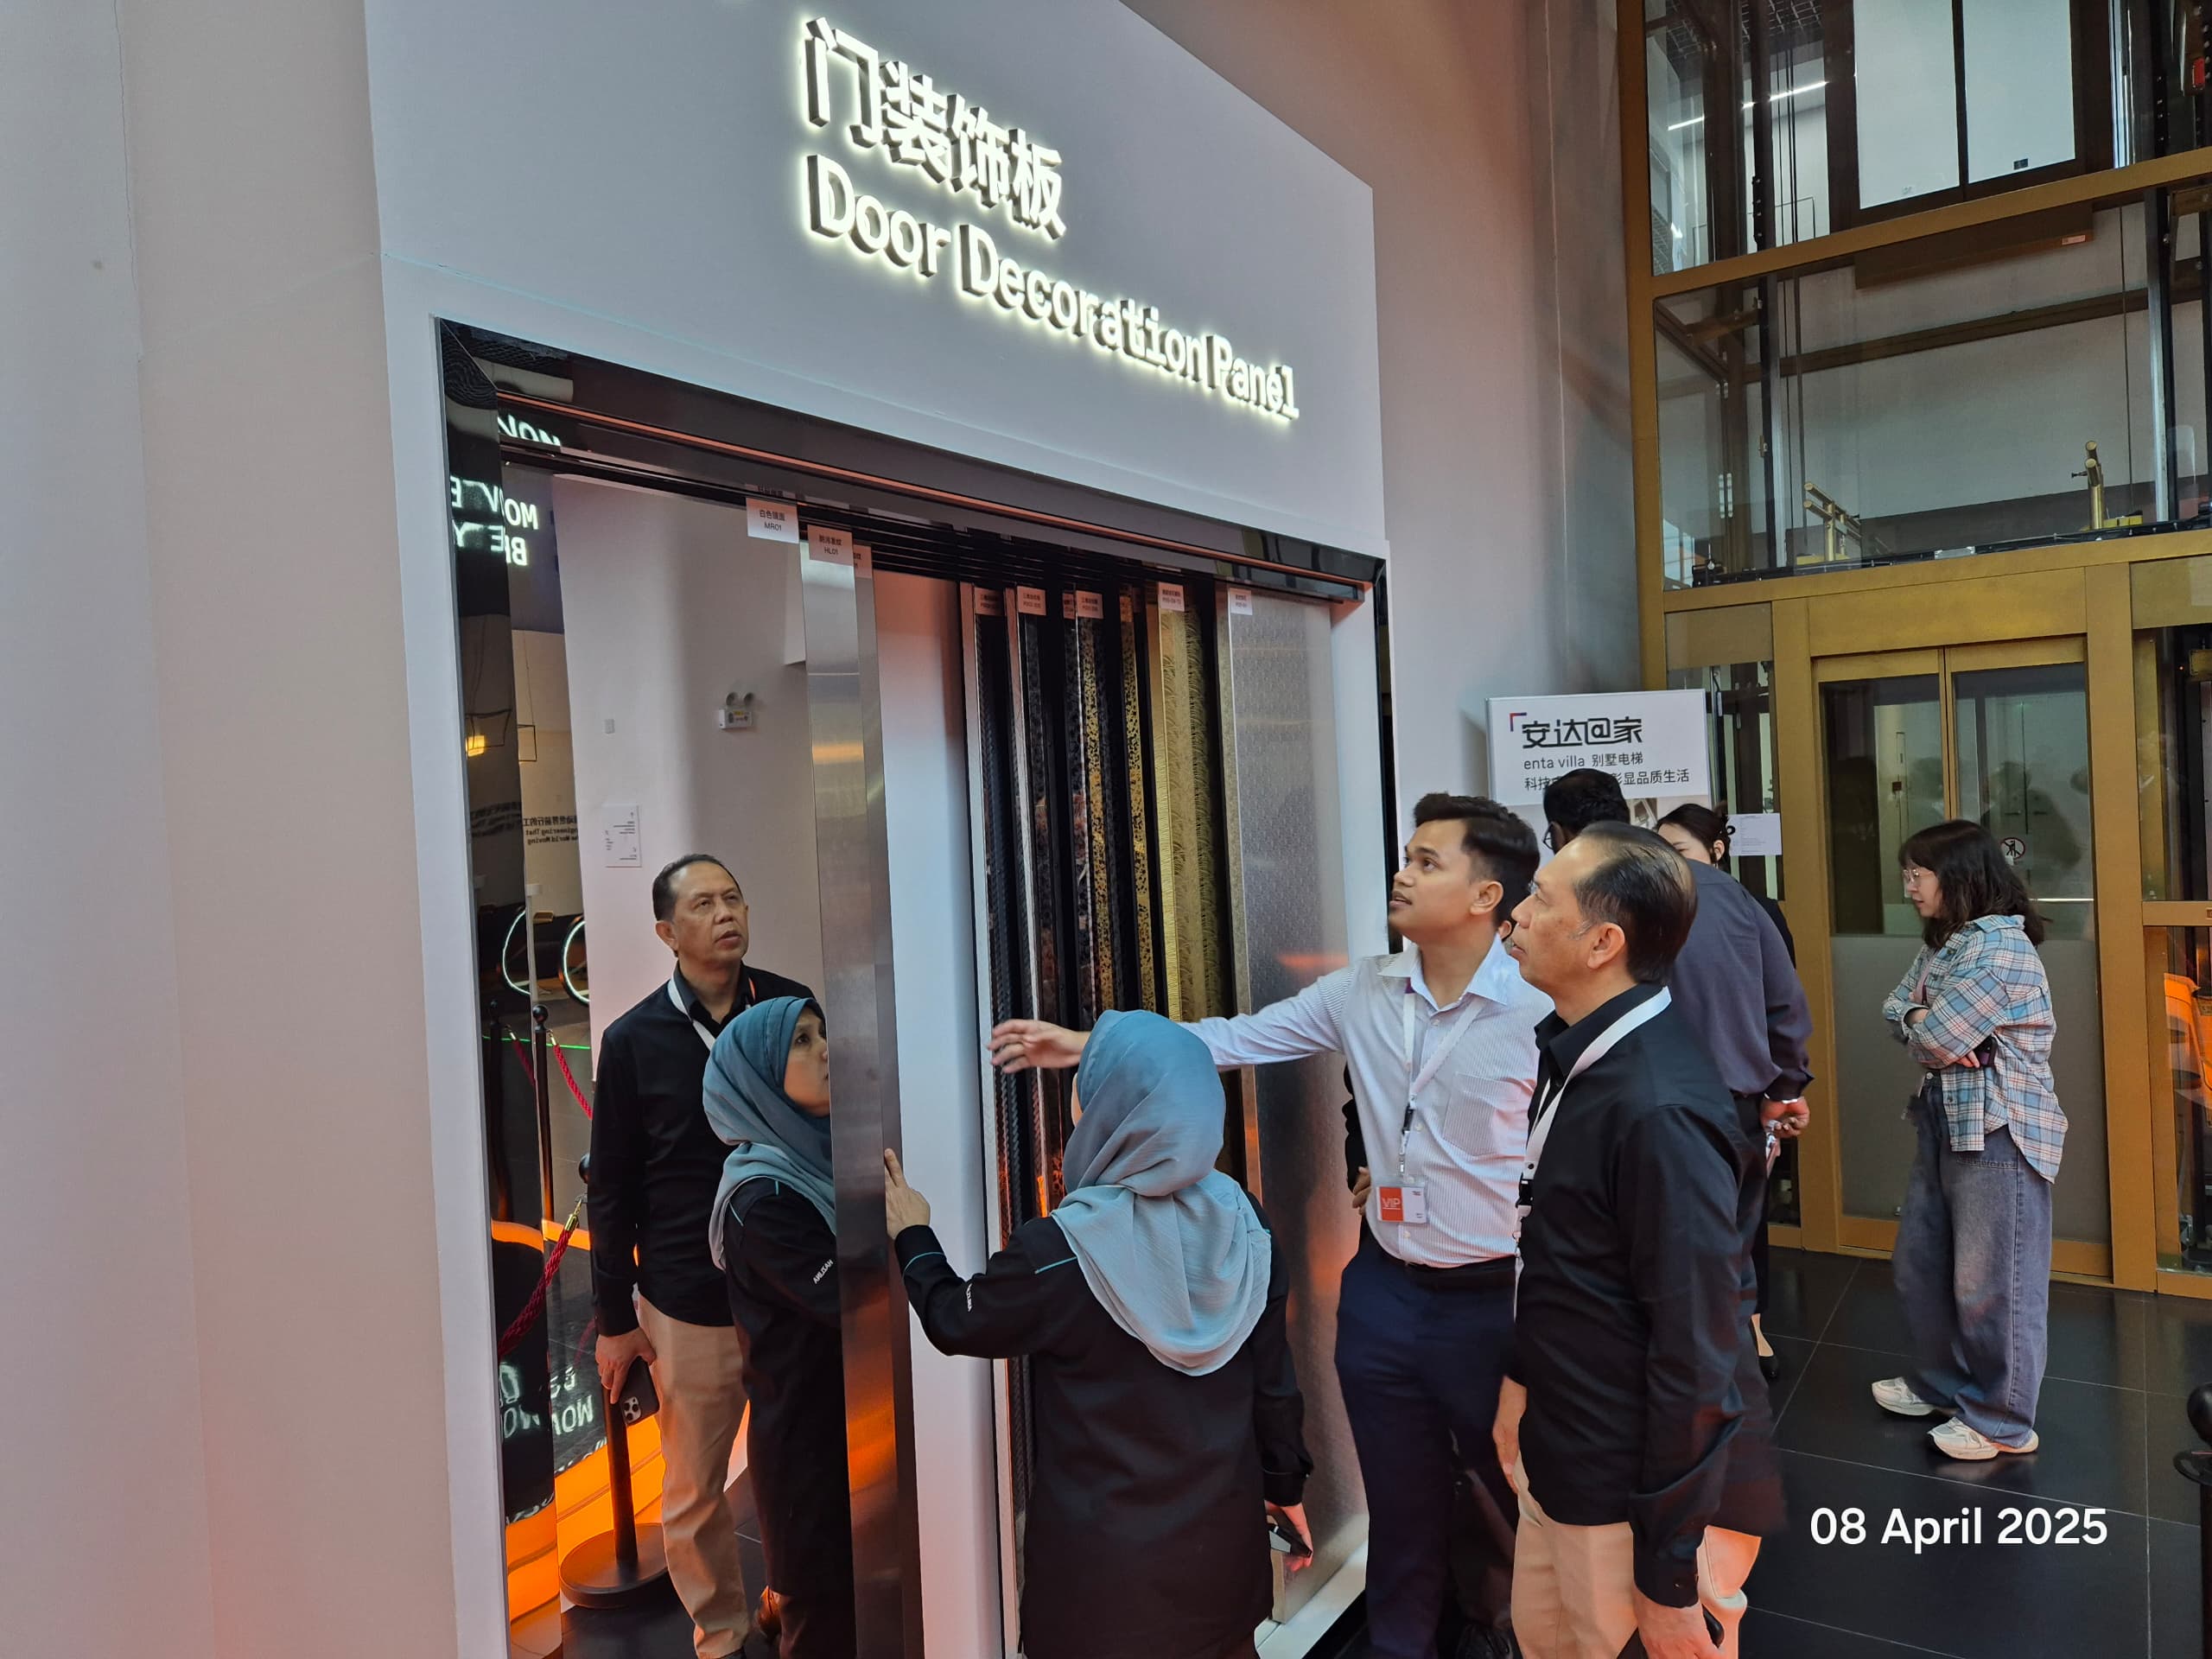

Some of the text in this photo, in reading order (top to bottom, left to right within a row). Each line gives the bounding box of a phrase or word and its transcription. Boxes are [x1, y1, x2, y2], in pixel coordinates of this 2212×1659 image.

[804, 17, 1066, 240] 门装饰板
[807, 155, 1300, 420] Door Decoration Panel
[1523, 753, 1643, 770] enta villa 别墅电梯
[1524, 775, 1561, 791] 科技
[1382, 1198, 1401, 1208] VIP
